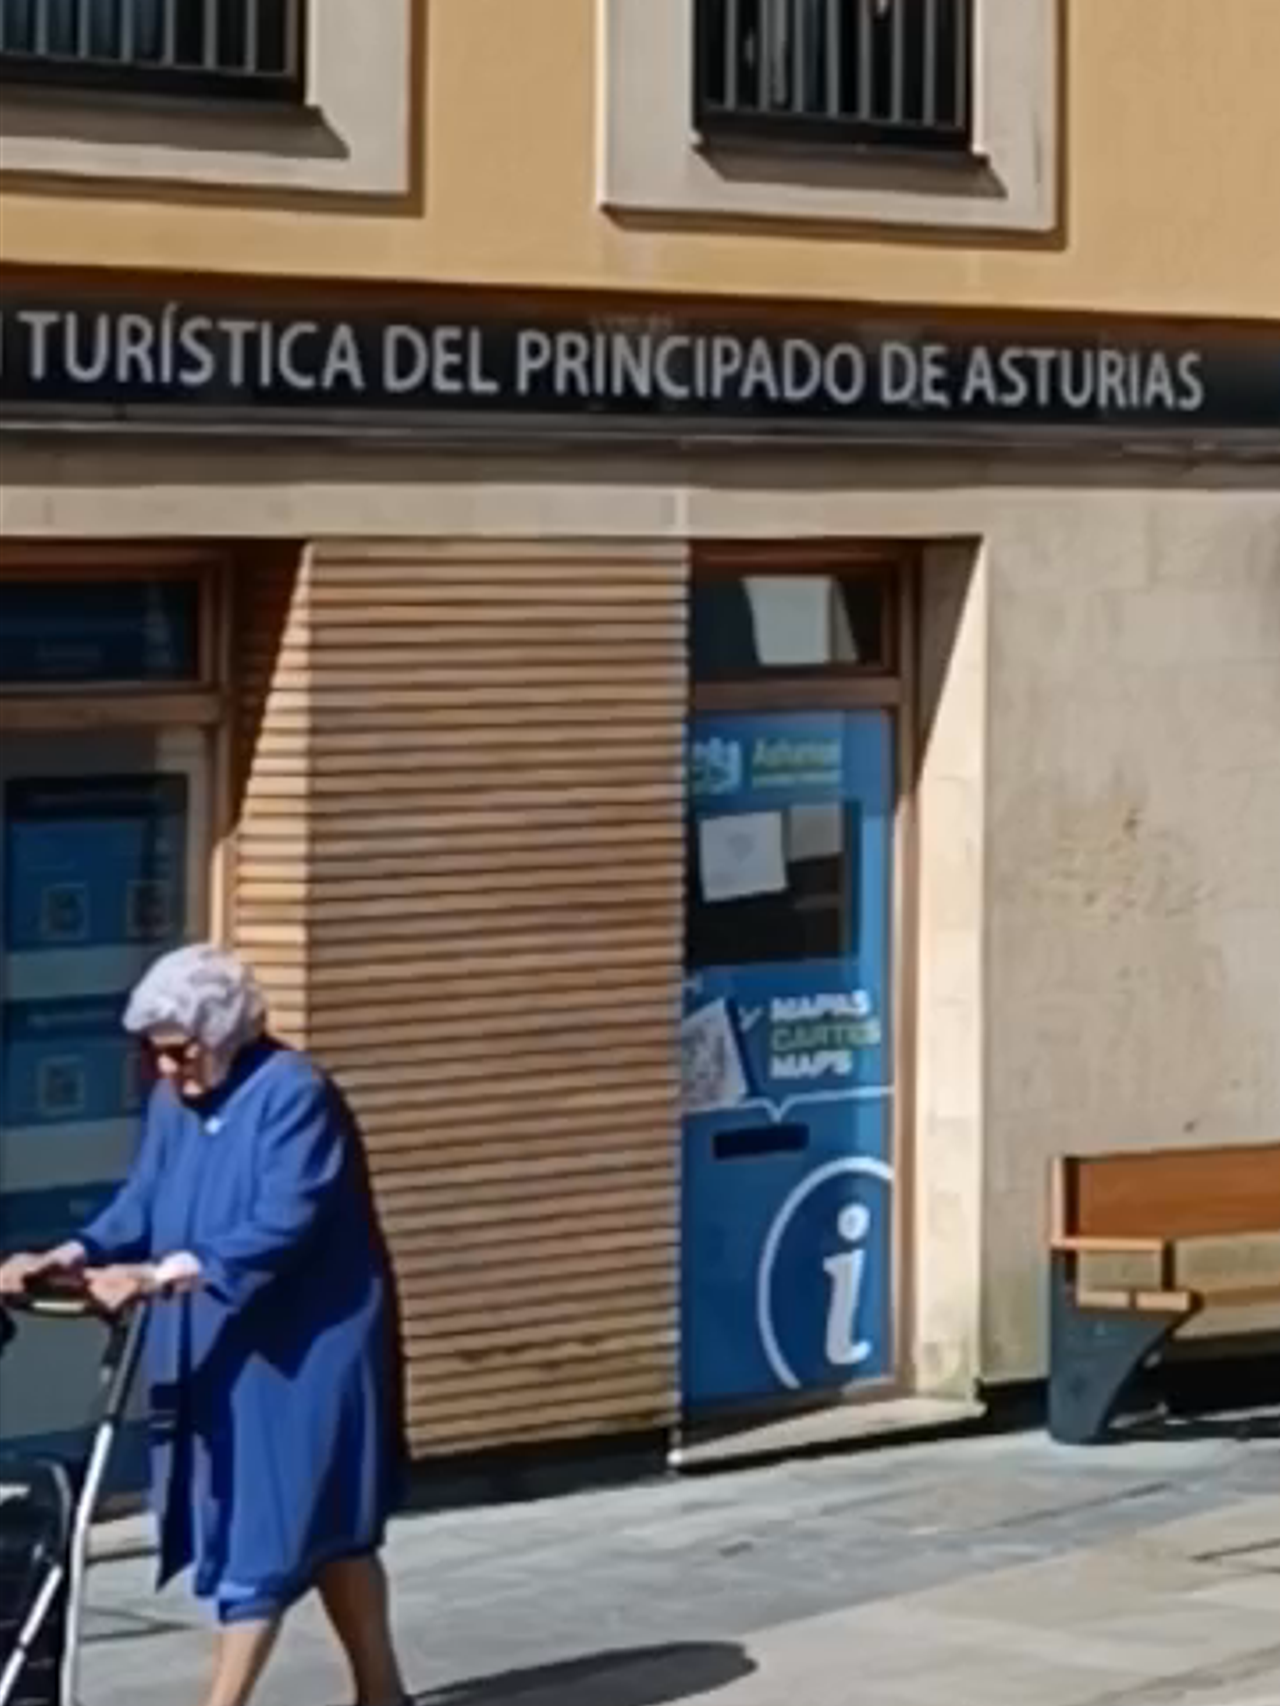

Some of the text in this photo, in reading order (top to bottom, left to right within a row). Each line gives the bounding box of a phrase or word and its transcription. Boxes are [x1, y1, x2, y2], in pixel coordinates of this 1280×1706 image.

[17, 301, 1205, 411] TURÍSTICA DEL PRINCIPADO DE ASTURIAS
